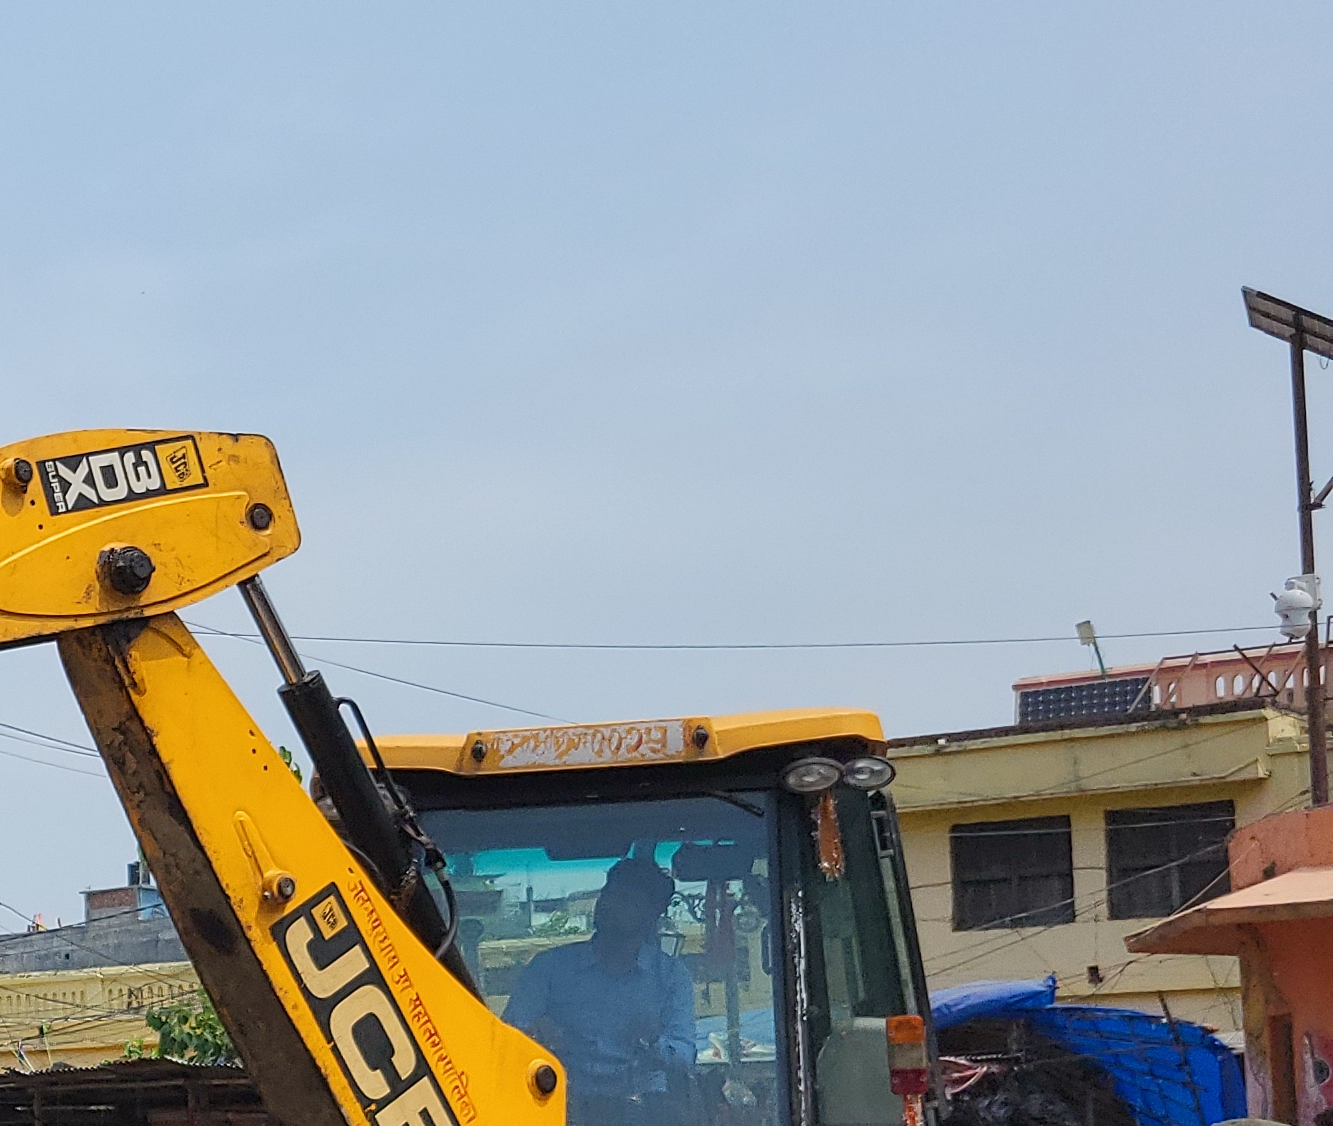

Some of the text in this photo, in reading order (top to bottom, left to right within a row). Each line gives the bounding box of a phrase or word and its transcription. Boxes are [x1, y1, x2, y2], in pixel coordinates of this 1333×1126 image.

[44, 461, 66, 513] SUPER
[57, 449, 162, 511] 3DX
[169, 448, 191, 481] JCB
